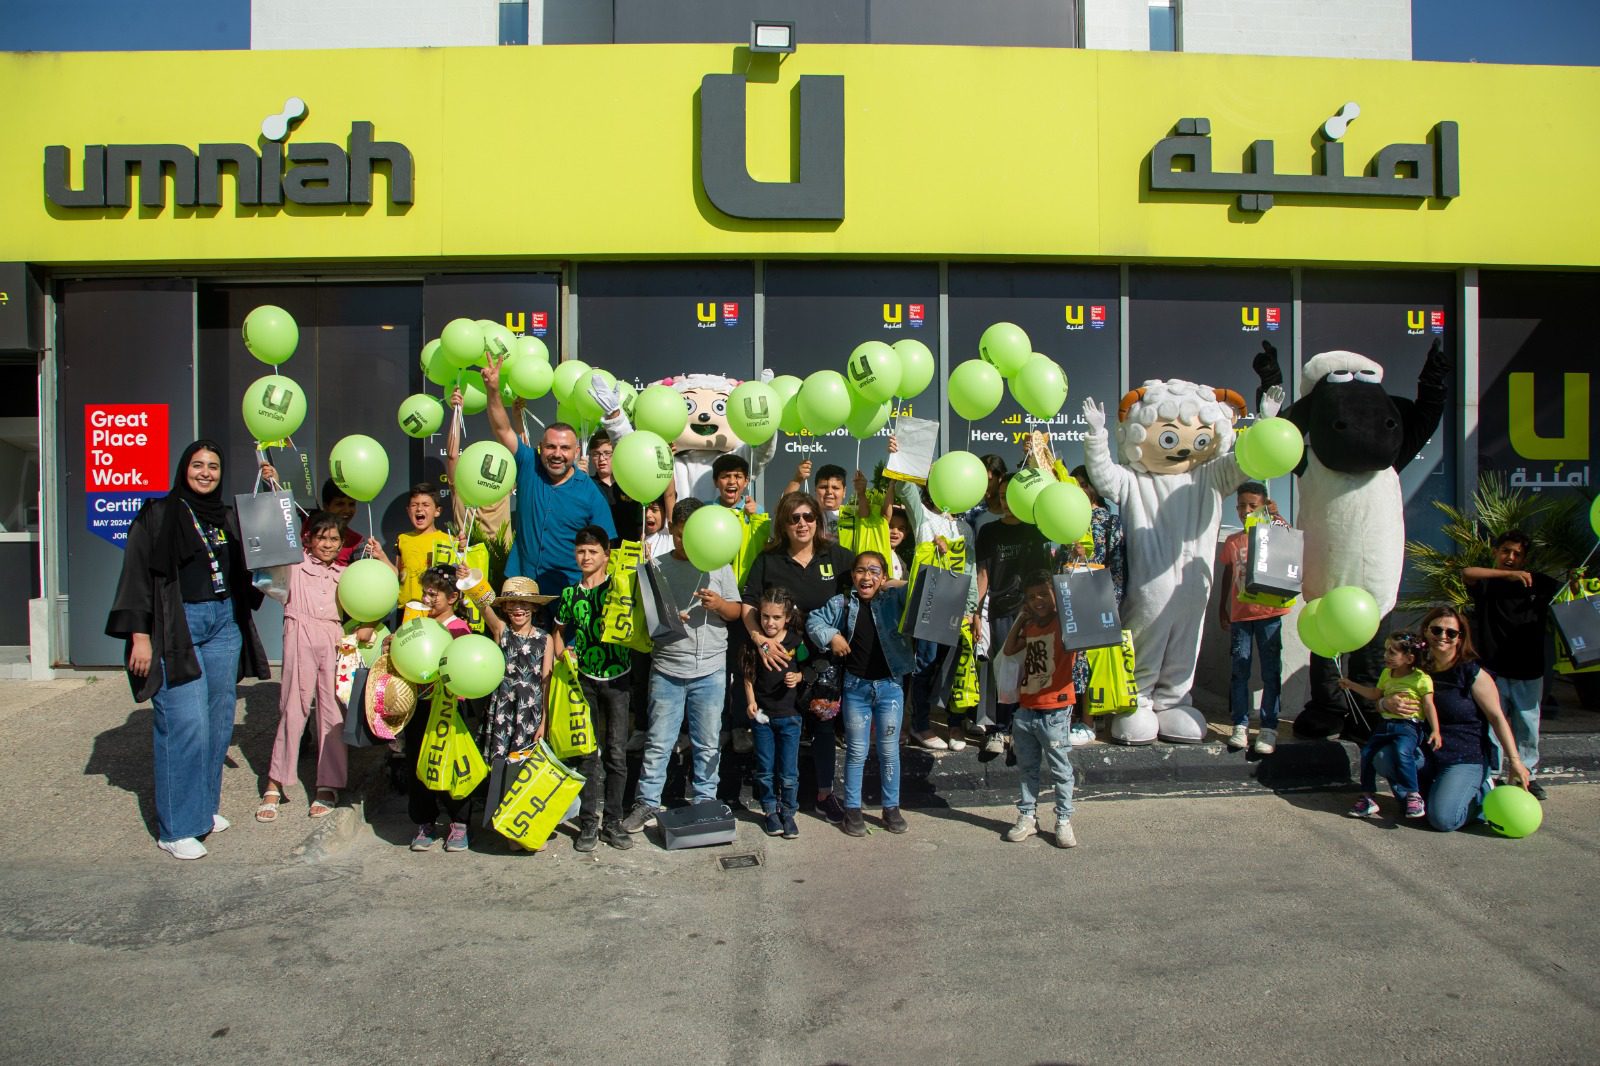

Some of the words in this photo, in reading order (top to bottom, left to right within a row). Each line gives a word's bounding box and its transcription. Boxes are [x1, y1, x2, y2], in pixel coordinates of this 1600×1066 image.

[44, 97, 414, 207] umniah
[91, 410, 148, 427] Great
[258, 408, 285, 422] umniah
[92, 429, 148, 447] Place
[971, 430, 1008, 442] Here,
[785, 441, 827, 453] Check.
[91, 449, 113, 466] To
[477, 479, 501, 491] umniah
[95, 498, 142, 512] Certifi
[93, 519, 109, 527] MAY
